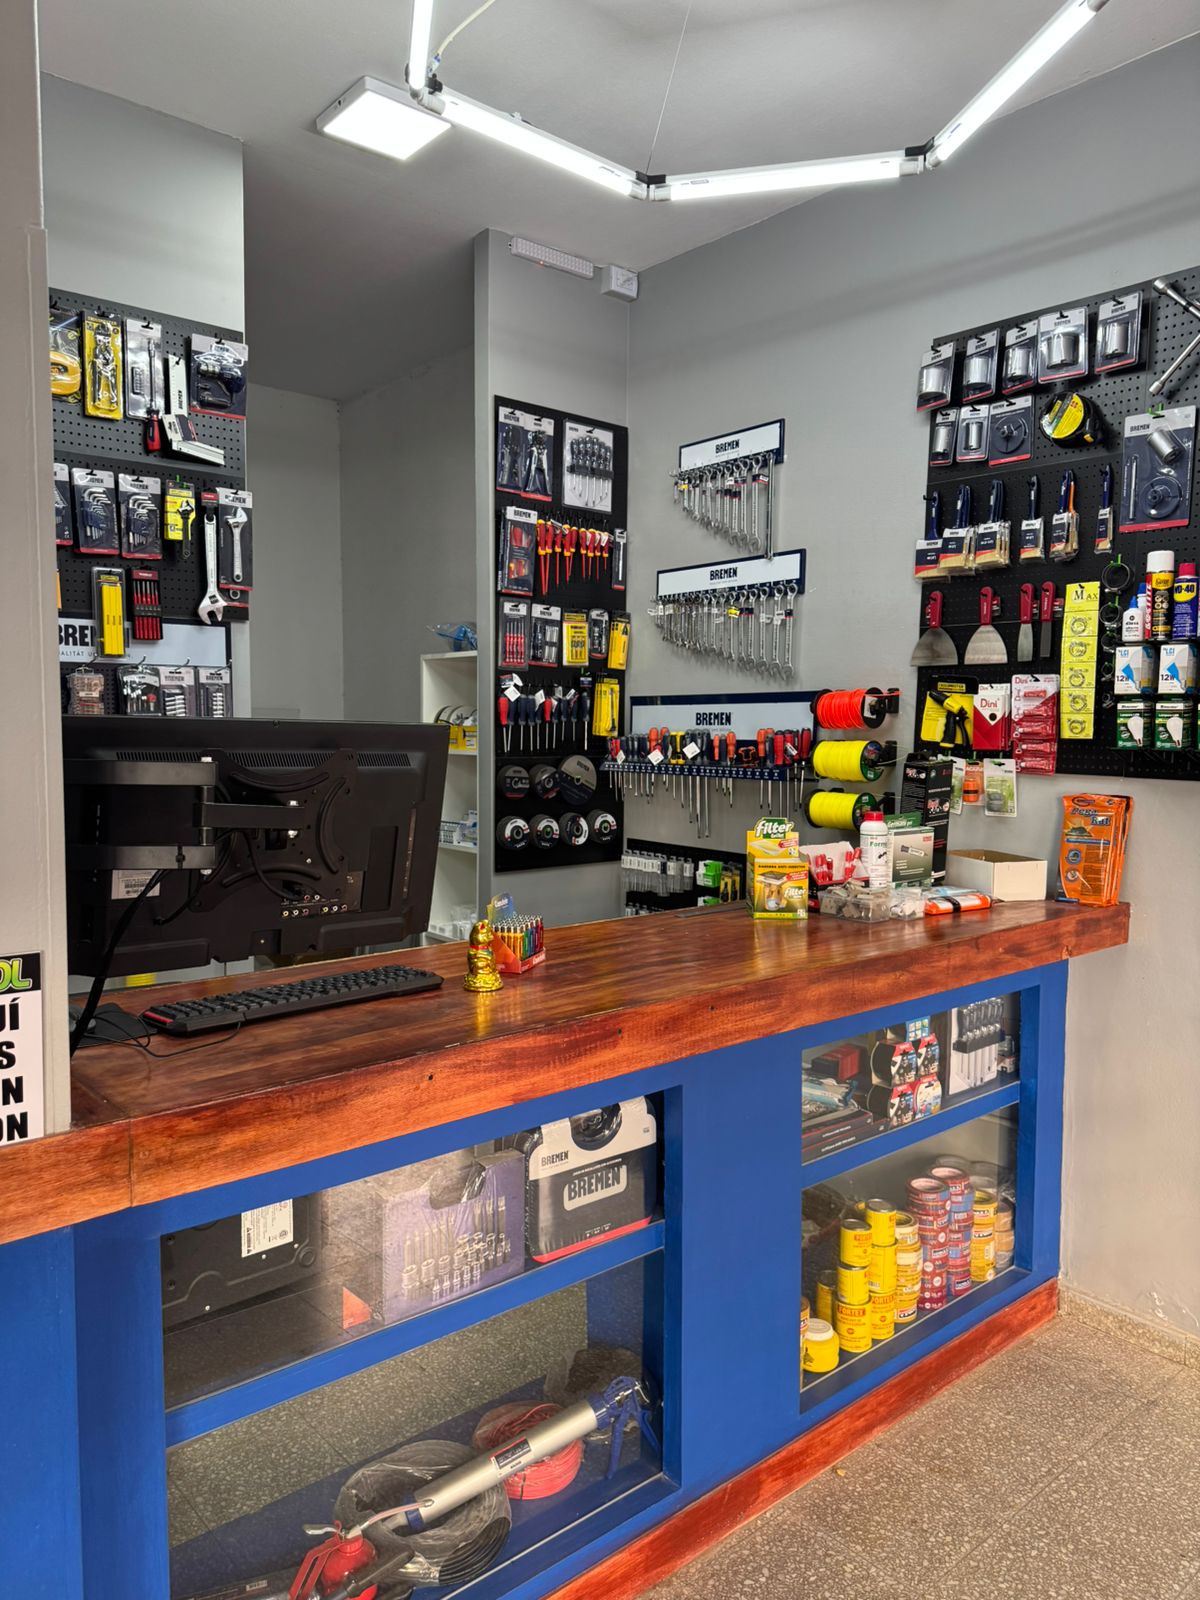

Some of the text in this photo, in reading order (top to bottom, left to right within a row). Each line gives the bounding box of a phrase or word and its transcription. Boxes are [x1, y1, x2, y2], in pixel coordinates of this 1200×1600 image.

[715, 439, 740, 454] BREMEN
[709, 567, 738, 581] BREMEN
[980, 698, 997, 708] Dini
[695, 712, 731, 726] BREMEN
[756, 820, 793, 838] filter
[541, 1151, 569, 1167] BREMEN
[568, 1167, 621, 1201] BREMEN
